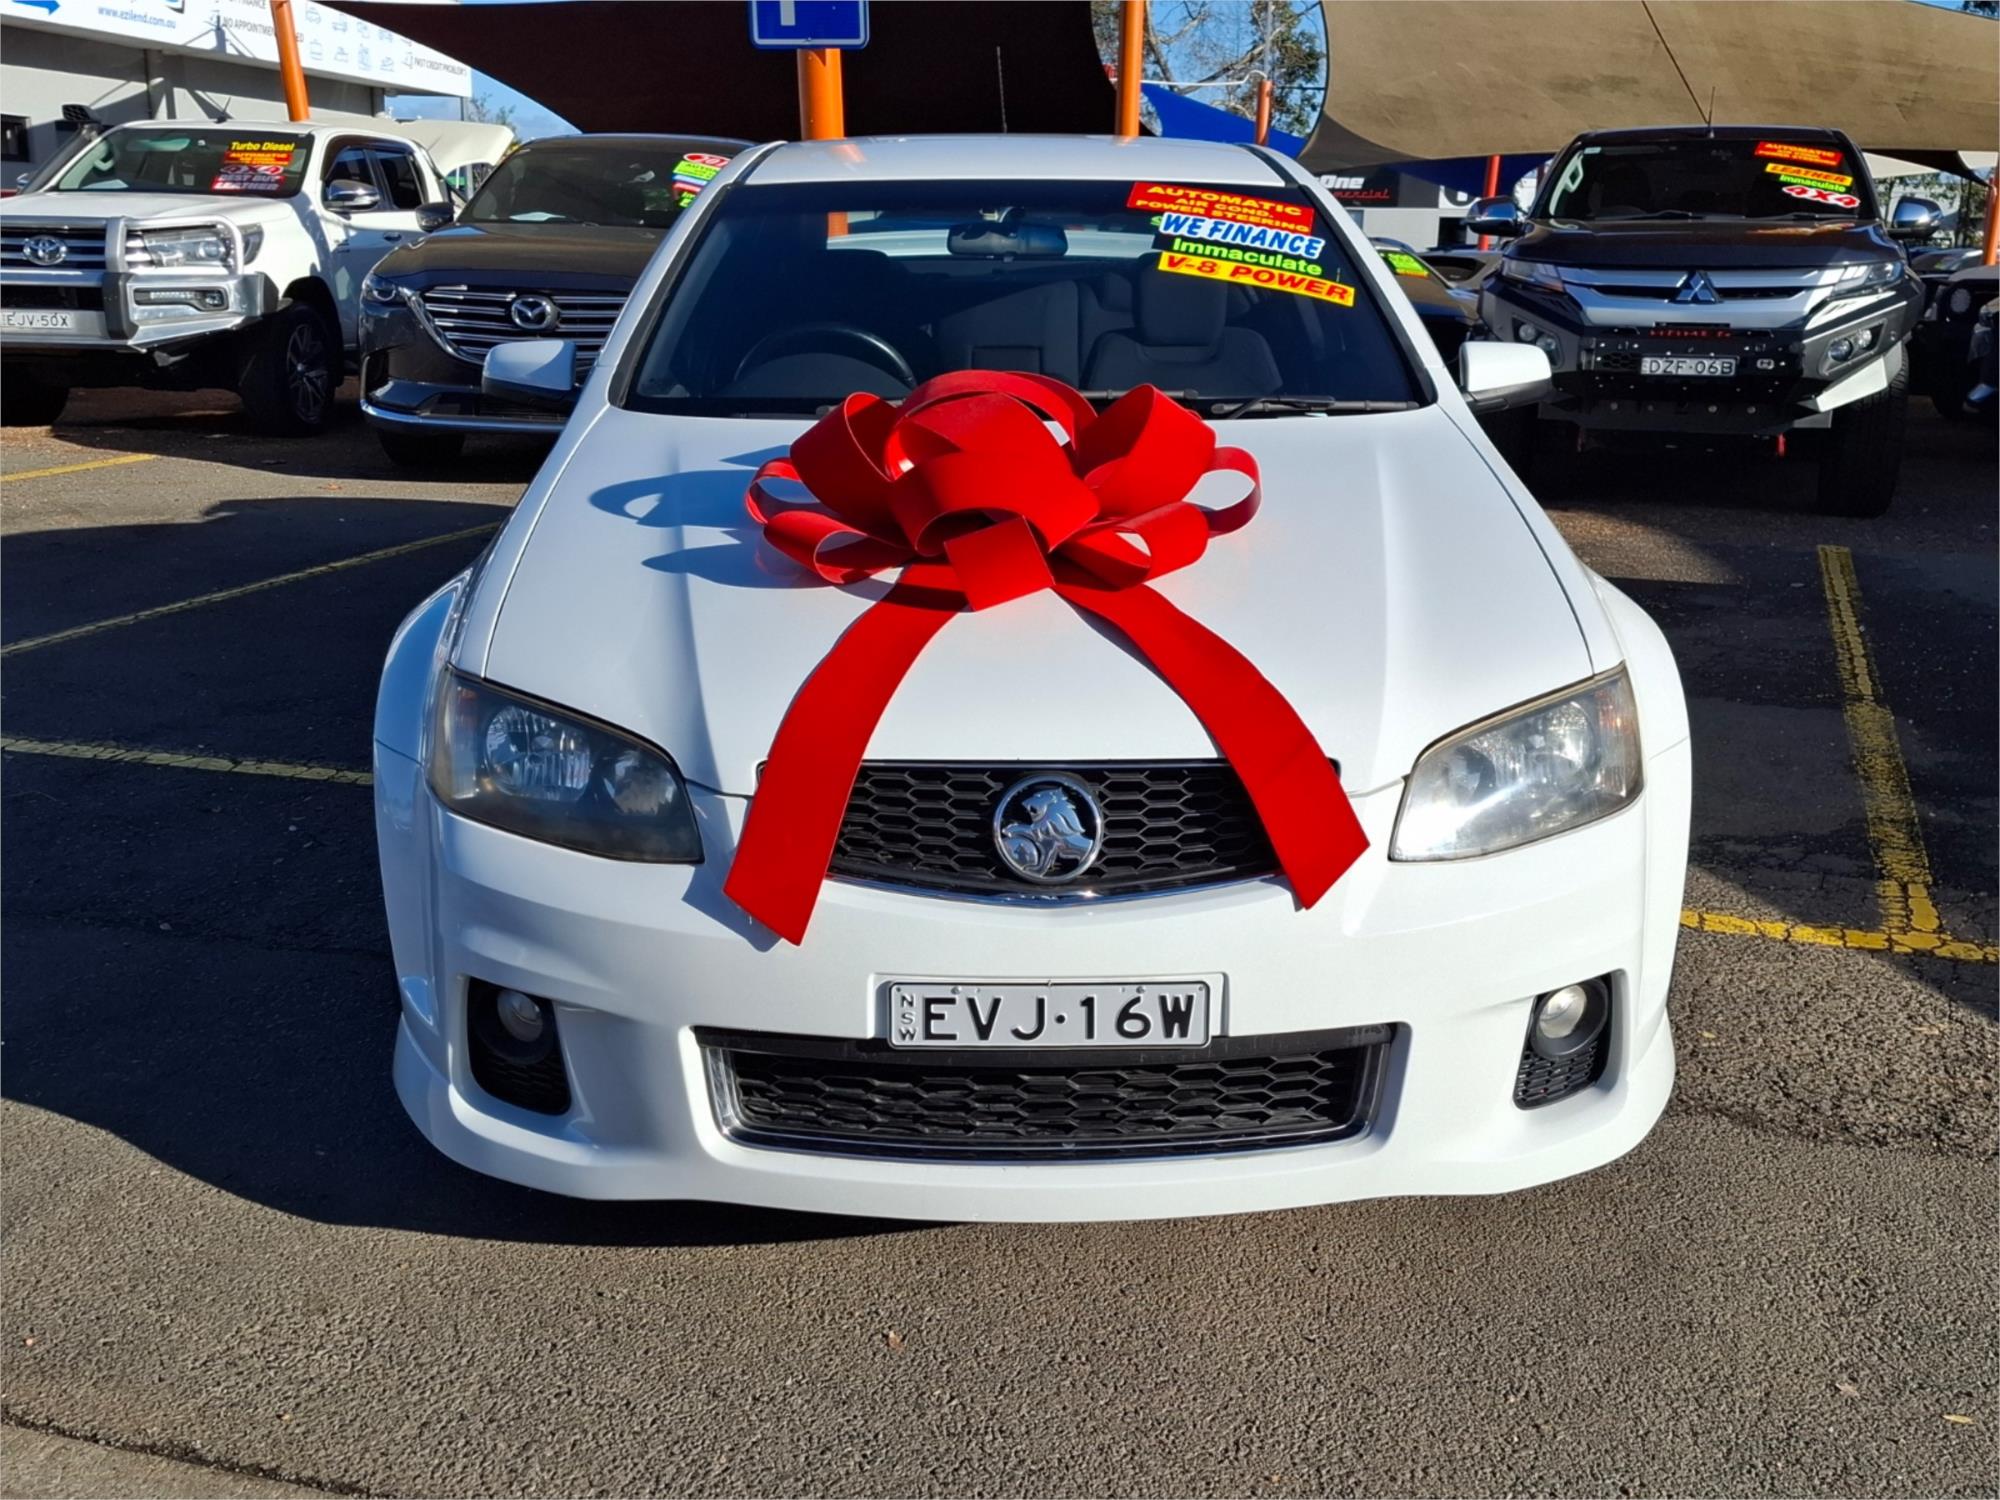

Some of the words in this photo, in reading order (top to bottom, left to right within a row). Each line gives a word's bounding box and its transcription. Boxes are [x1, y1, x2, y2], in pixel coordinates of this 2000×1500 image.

[234, 18, 275, 37] APPOINTME
[230, 142, 260, 151] Turbo
[261, 142, 295, 151] Diesel
[1317, 174, 1365, 190] One
[1772, 165, 1847, 184] LEATHER
[1779, 174, 1846, 193] Immaculate
[1146, 185, 1303, 217] AUTOMATIC
[1175, 198, 1208, 208] AIR
[1214, 203, 1274, 218] COND.
[1135, 199, 1206, 215] POWER
[1211, 209, 1310, 233] STEERING
[1162, 213, 1206, 236] WE
[1207, 220, 1322, 258] FINANCE
[1172, 238, 1323, 276] Immaculate
[1165, 255, 1217, 275] V-8
[1229, 267, 1349, 301] POWER
